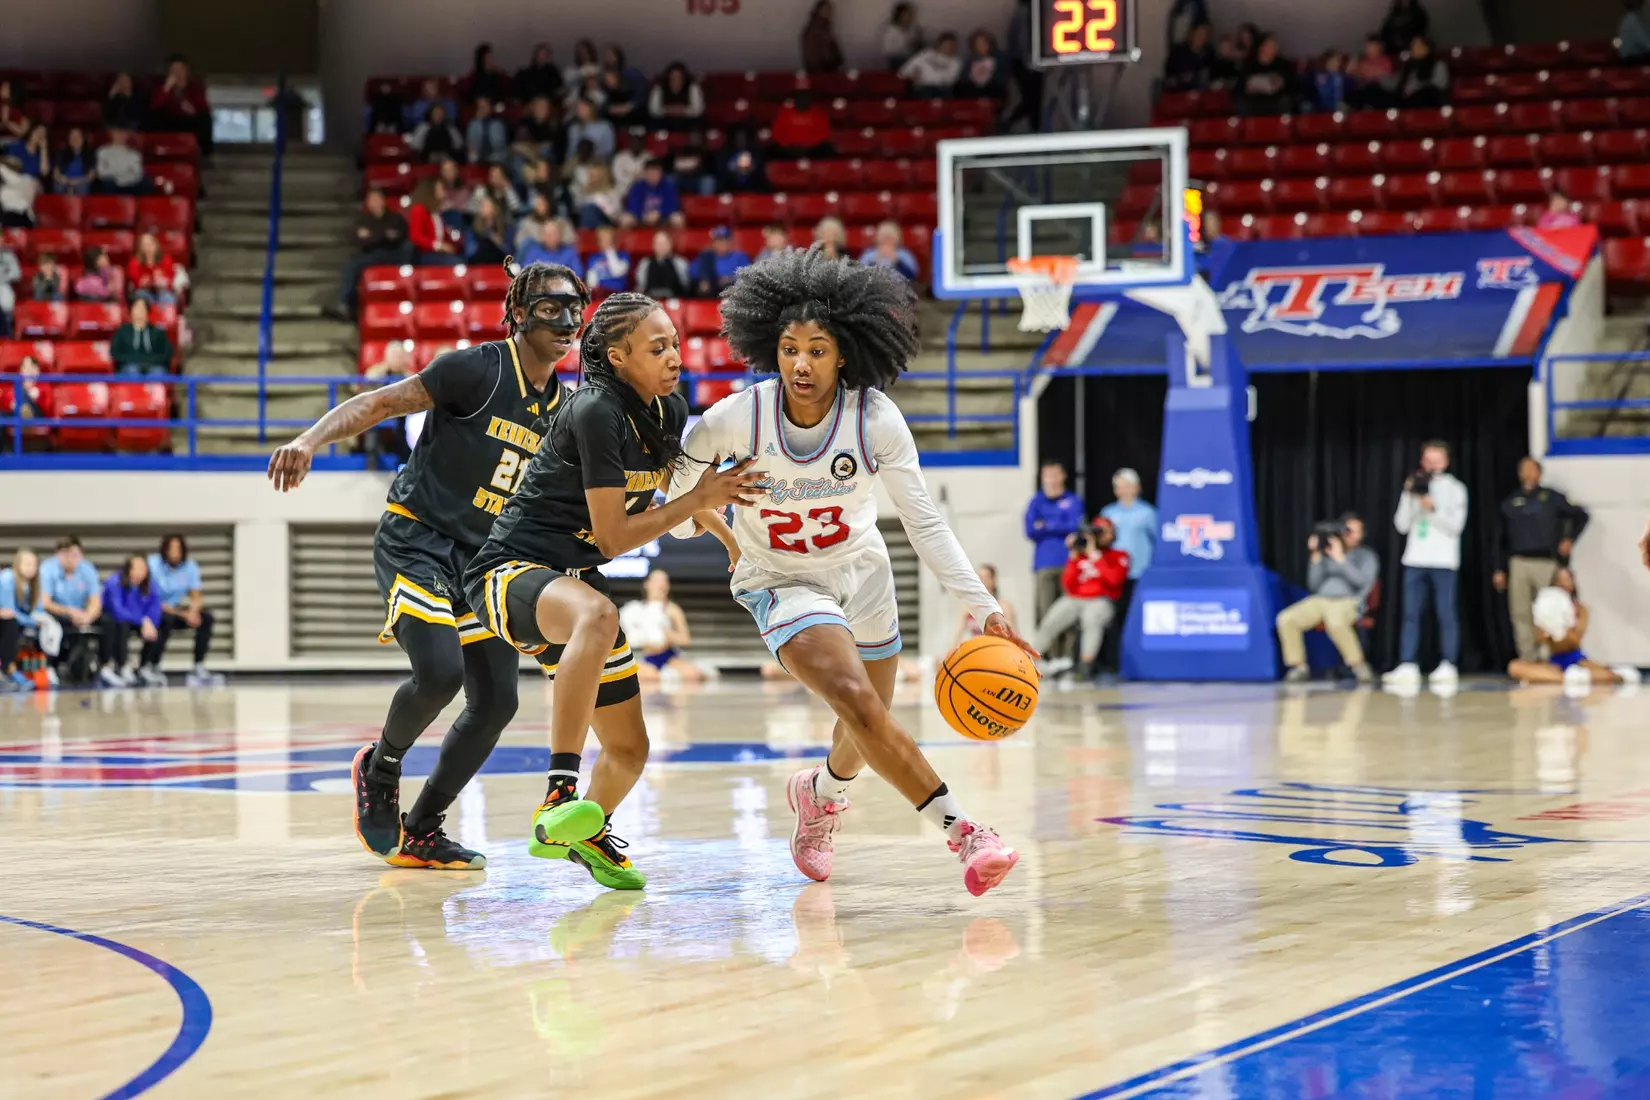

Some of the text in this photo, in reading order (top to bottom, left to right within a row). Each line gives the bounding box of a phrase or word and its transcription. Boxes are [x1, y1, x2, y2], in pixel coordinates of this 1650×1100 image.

[1052, 0, 1117, 53] 22
[490, 448, 530, 494] 21
[472, 486, 508, 516] STA
[760, 506, 850, 554] 23
[996, 687, 1032, 711] EVO
